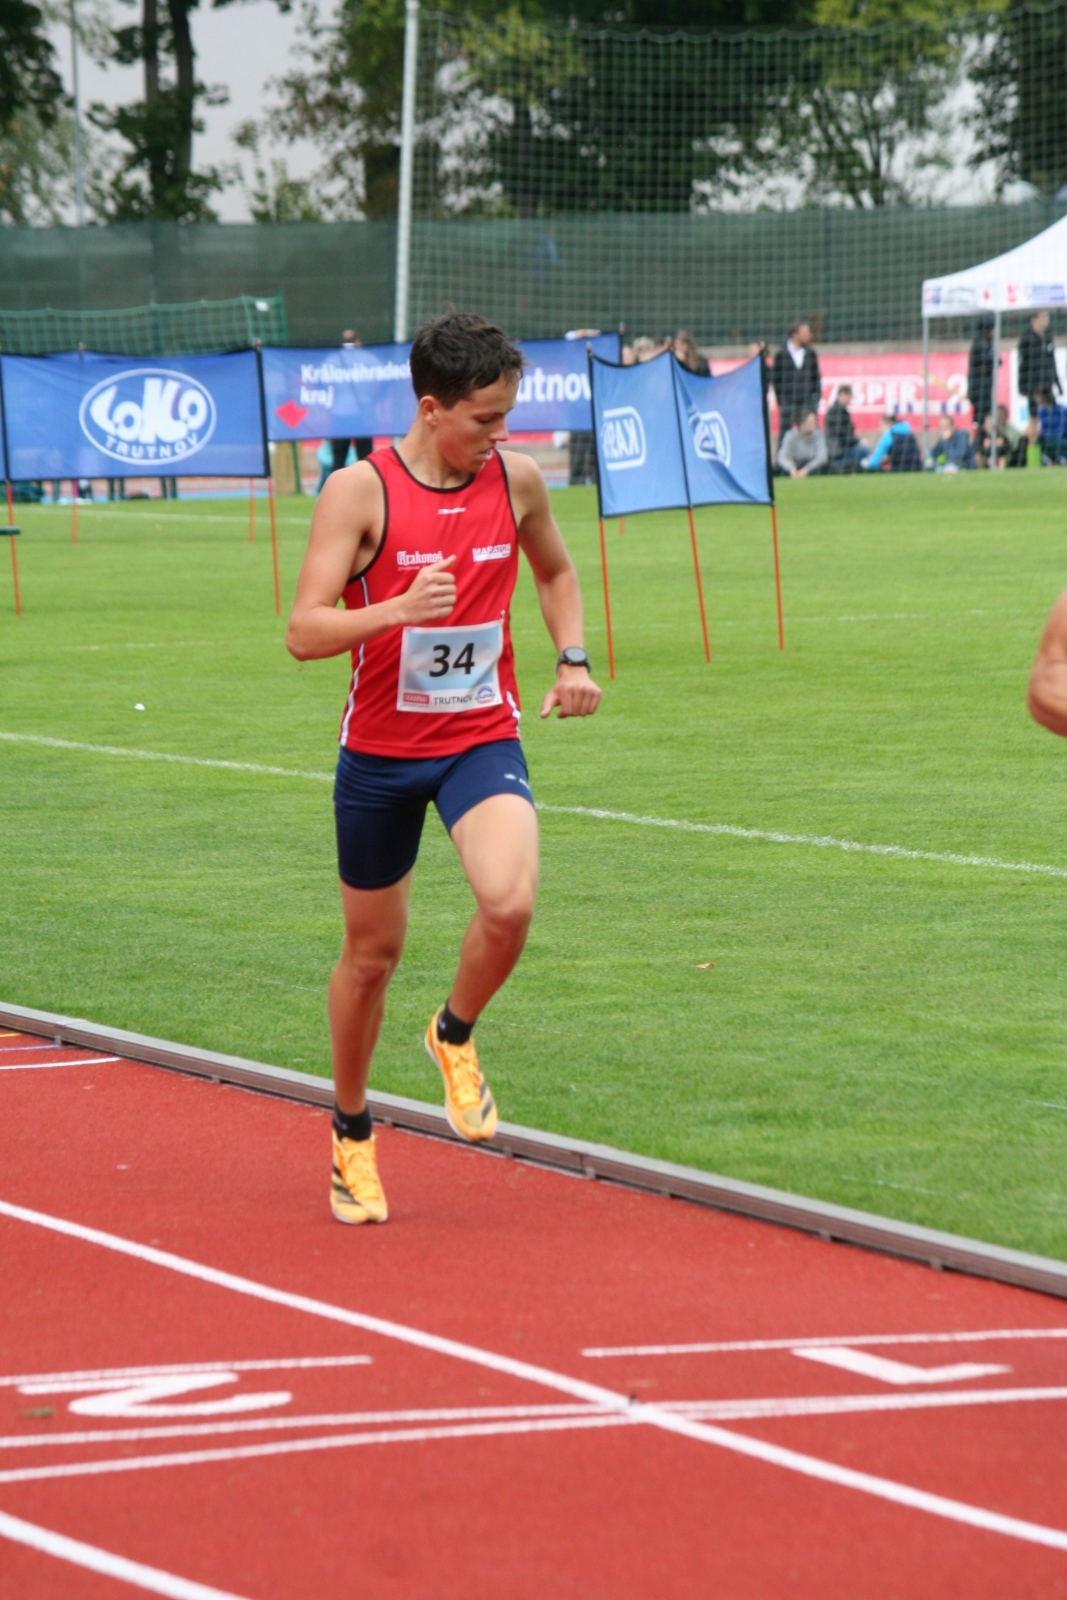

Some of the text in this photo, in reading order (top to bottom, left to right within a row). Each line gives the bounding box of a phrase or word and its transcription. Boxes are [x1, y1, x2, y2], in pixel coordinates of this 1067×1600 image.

[301, 385, 334, 409] kraj
[516, 367, 592, 403] utnov
[105, 432, 200, 459] TRUTNOV
[429, 642, 476, 678] 34
[433, 694, 473, 705] TRUTNOV
